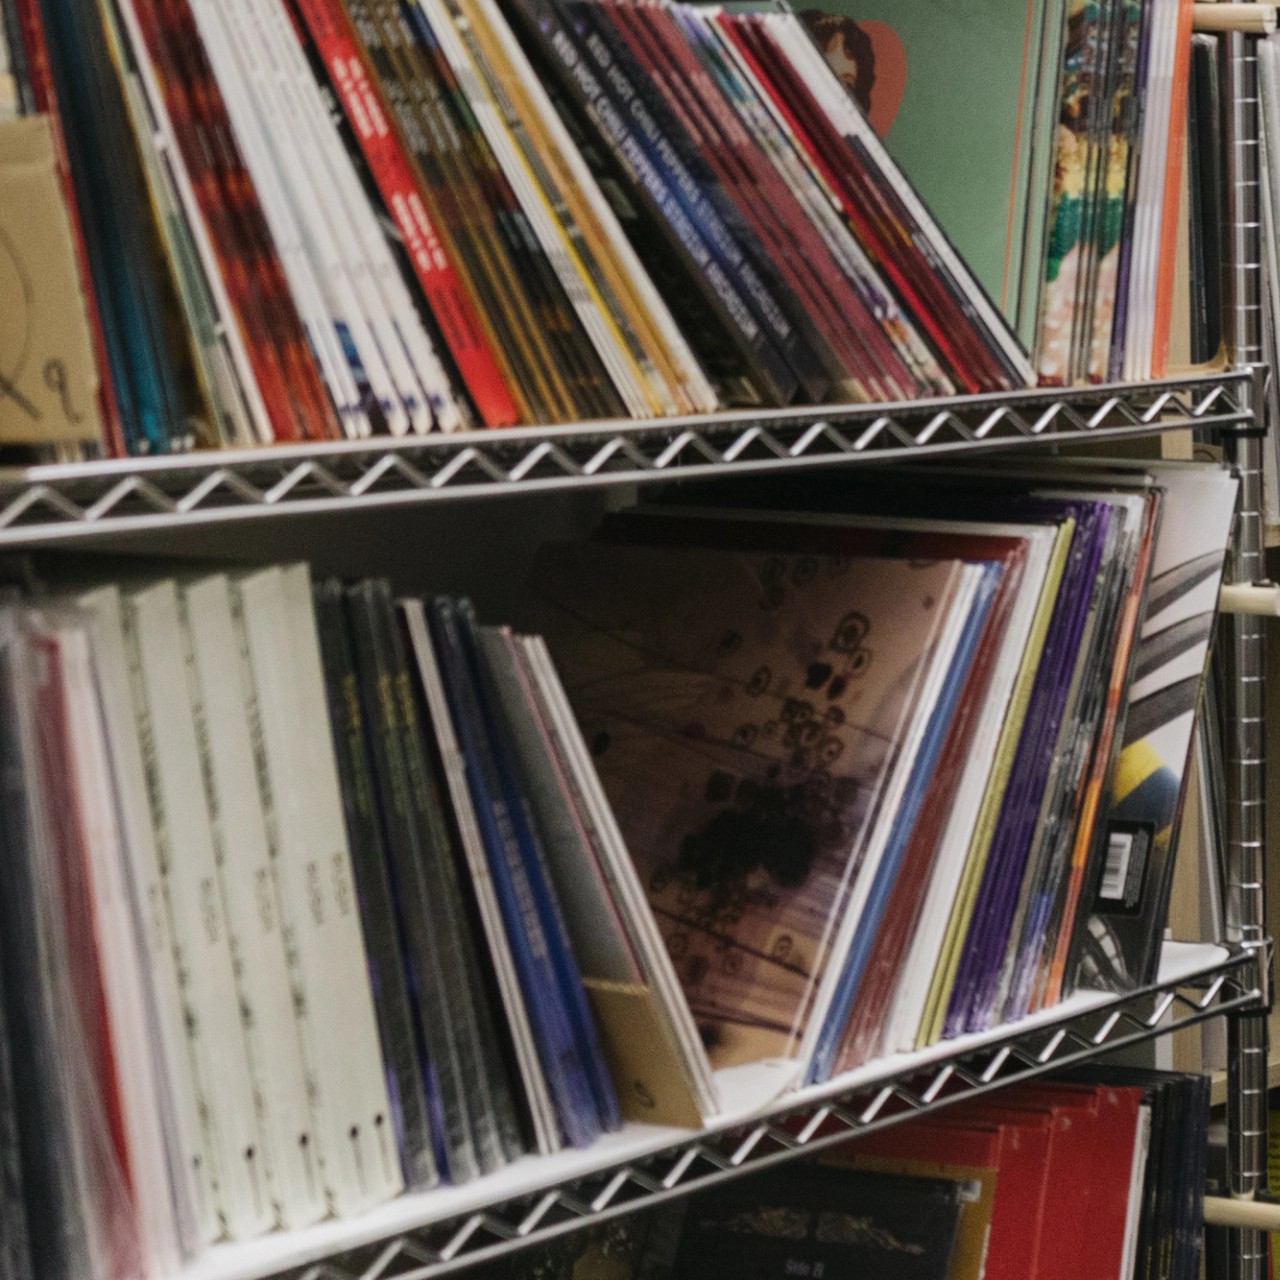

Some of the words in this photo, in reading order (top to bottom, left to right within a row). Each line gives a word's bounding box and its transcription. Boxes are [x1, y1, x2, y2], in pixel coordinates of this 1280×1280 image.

[572, 64, 600, 99] HOT
[620, 137, 669, 203] PEPPERS
[607, 67, 636, 103] HOT
[654, 138, 702, 202] PEPPERS
